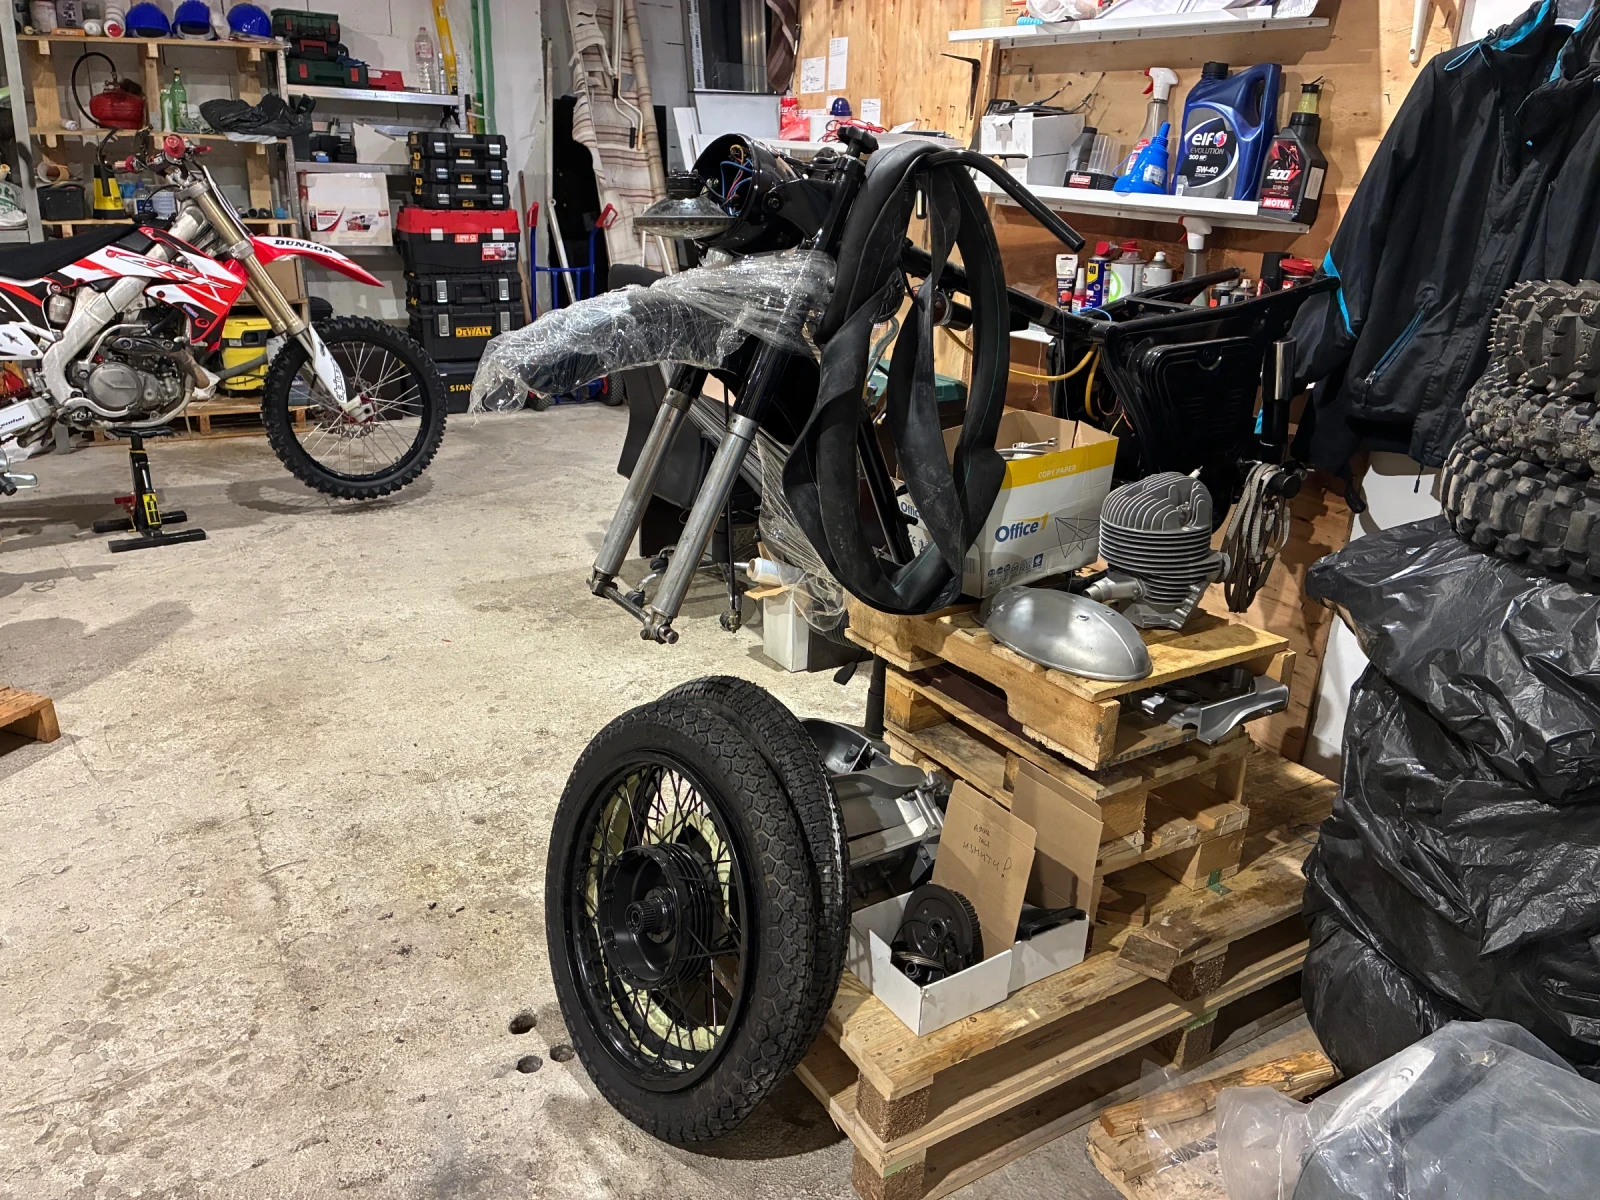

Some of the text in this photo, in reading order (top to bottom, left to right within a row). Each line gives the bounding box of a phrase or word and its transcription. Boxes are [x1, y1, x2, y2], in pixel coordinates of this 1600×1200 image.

[1192, 133, 1214, 145] elf
[1190, 147, 1225, 155] EVOLUTION
[1195, 165, 1219, 174] 5W-40
[1264, 199, 1290, 208] MOTUL
[274, 239, 333, 254] DUNLOP
[1038, 464, 1078, 479] COPY PAPER
[995, 521, 1038, 542] Office
